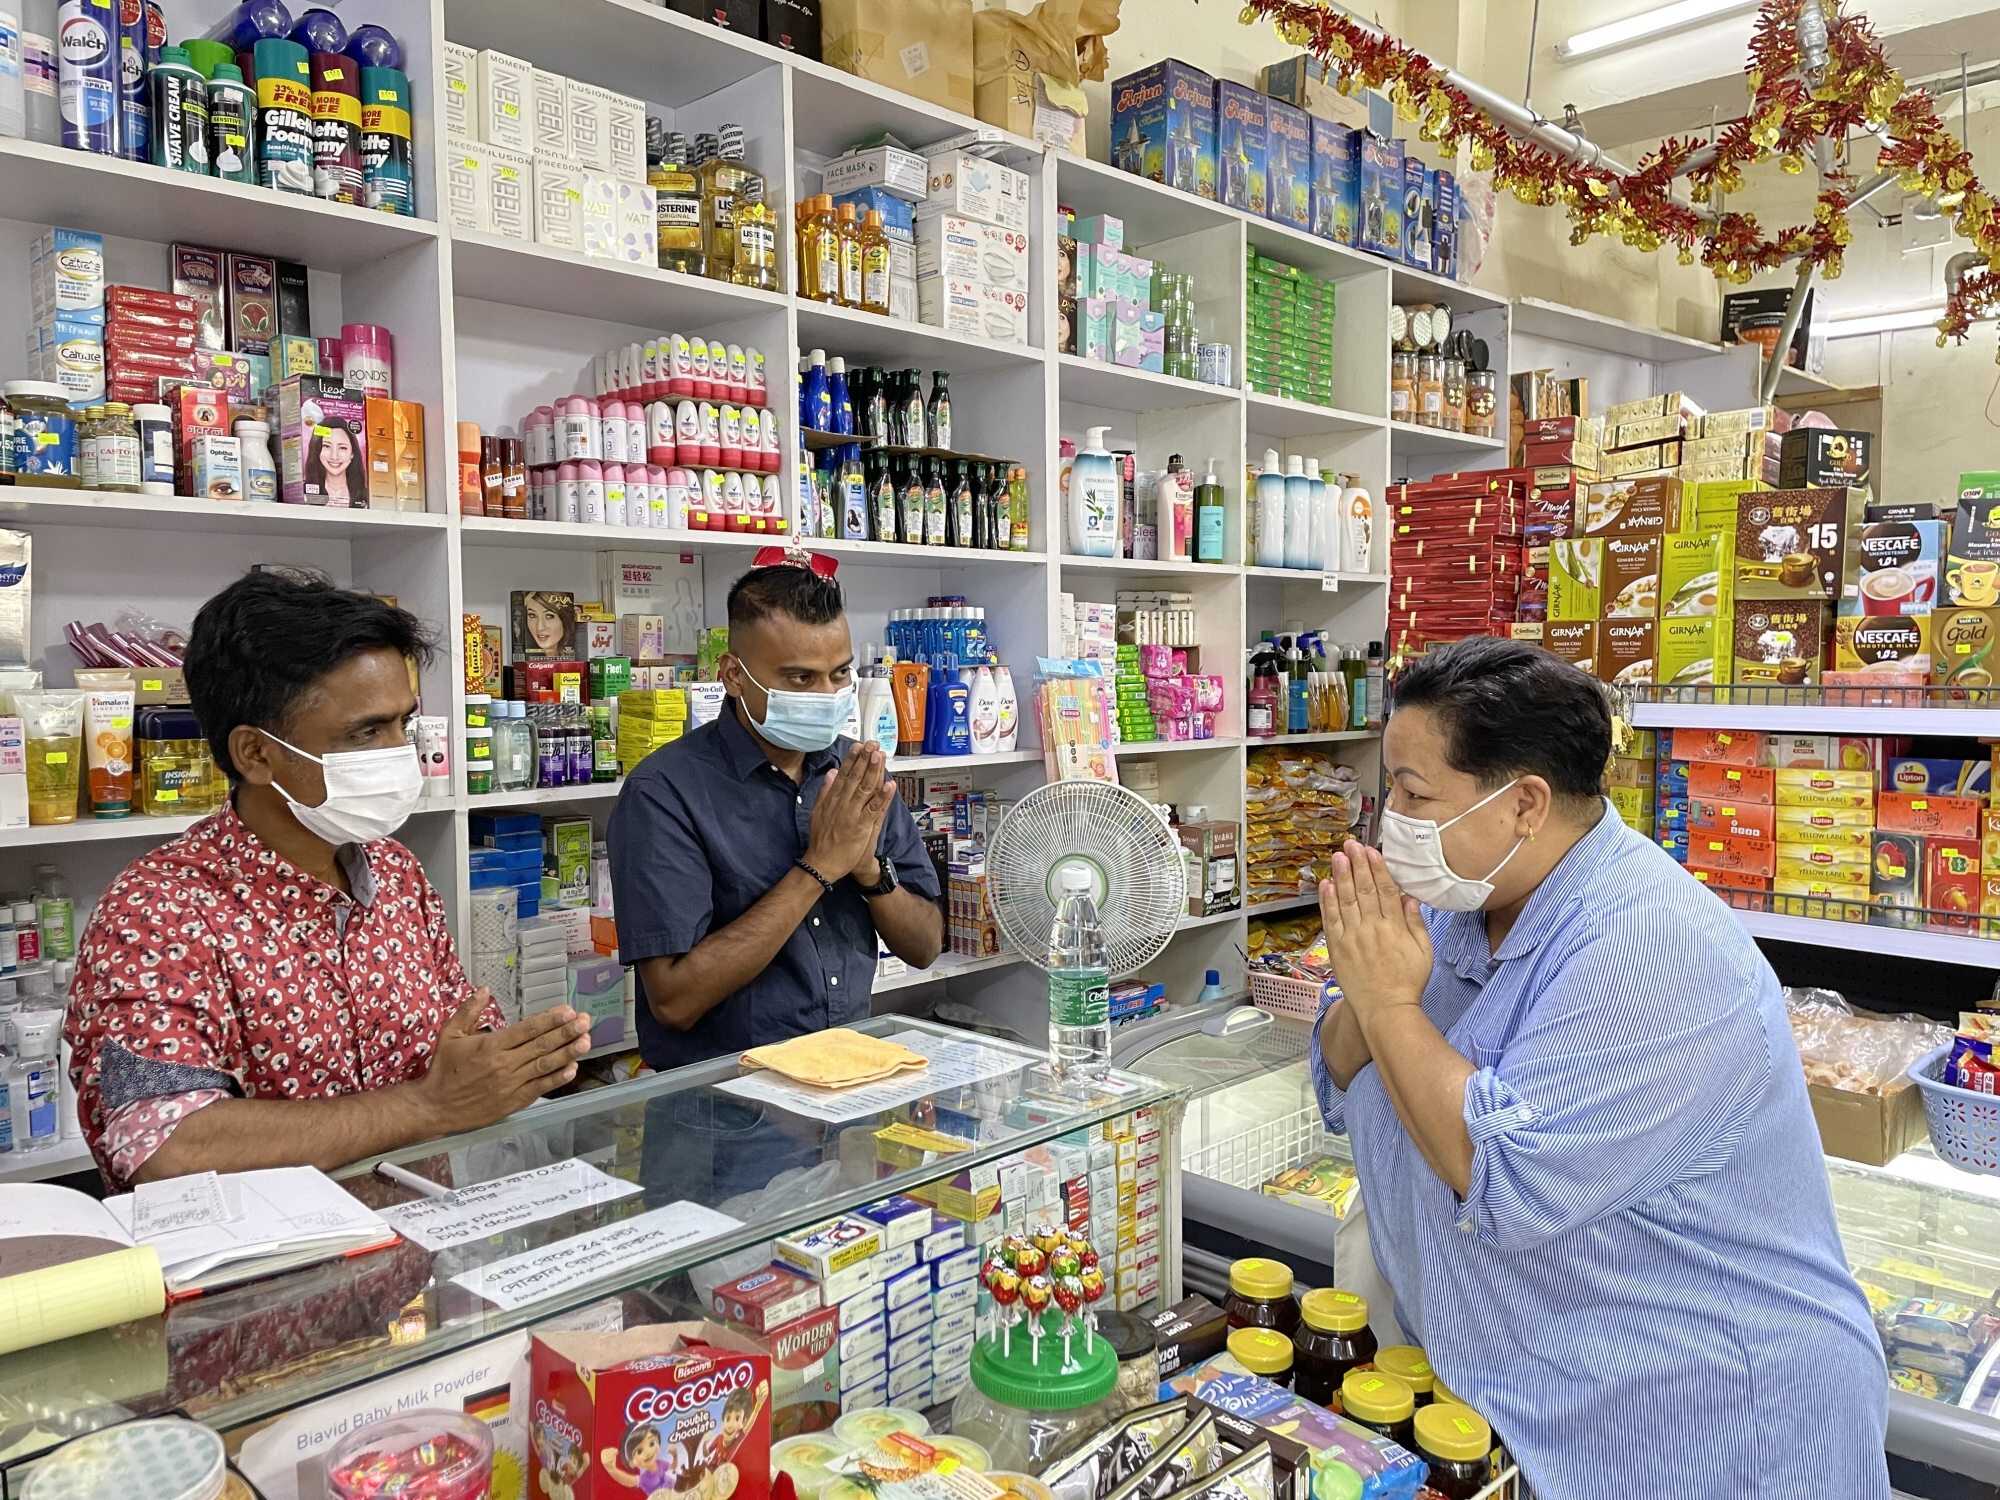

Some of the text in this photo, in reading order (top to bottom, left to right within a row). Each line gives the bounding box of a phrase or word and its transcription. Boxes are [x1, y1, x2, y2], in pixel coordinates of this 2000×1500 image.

[62, 36, 106, 50] Walch
[490, 55, 531, 73] MOMENT
[84, 82, 110, 91] SPRAY
[274, 84, 295, 94] 33%
[316, 97, 340, 105] MORE
[1116, 83, 1163, 113] Arjun
[1173, 79, 1212, 110] Arjun
[1225, 98, 1265, 128] Arjun
[168, 77, 182, 166] SHAVE CREAM
[213, 116, 241, 126] SENSITIVE
[1270, 113, 1306, 141] Arjun
[488, 150, 532, 166] ILUSION
[538, 159, 583, 173] FREEDOM
[828, 161, 866, 178] FACE MASK
[350, 369, 389, 383] POND'S
[1536, 500, 1570, 512] Masala
[1807, 523, 1838, 549] 15
[1614, 542, 1649, 554] GIRNAR
[1673, 539, 1711, 554] GIRNAR
[1551, 625, 1585, 638] GIRNAR
[1609, 625, 1645, 638] GIRNAR
[1669, 624, 1705, 637] GIRNAR
[606, 663, 622, 674] Fleet
[978, 698, 994, 706] Dove
[1811, 780, 1833, 788] Lipton
[1899, 773, 1925, 783] Lipton
[1799, 795, 1826, 803] YELLOW
[1811, 817, 1833, 825] Lipton
[1799, 832, 1848, 841] YELLOW LABEL
[1810, 853, 1833, 862] Lipton
[1799, 870, 1847, 879] YELLOW LABEL
[427, 1219, 468, 1235] One
[472, 1203, 531, 1225] plastic
[532, 1193, 568, 1209] bag
[435, 1230, 470, 1242] big
[484, 1211, 532, 1229] dollar
[397, 1391, 429, 1414] Milk
[433, 1366, 491, 1397] Powder
[677, 1411, 709, 1430] Double
[668, 1420, 717, 1444] chocolate
